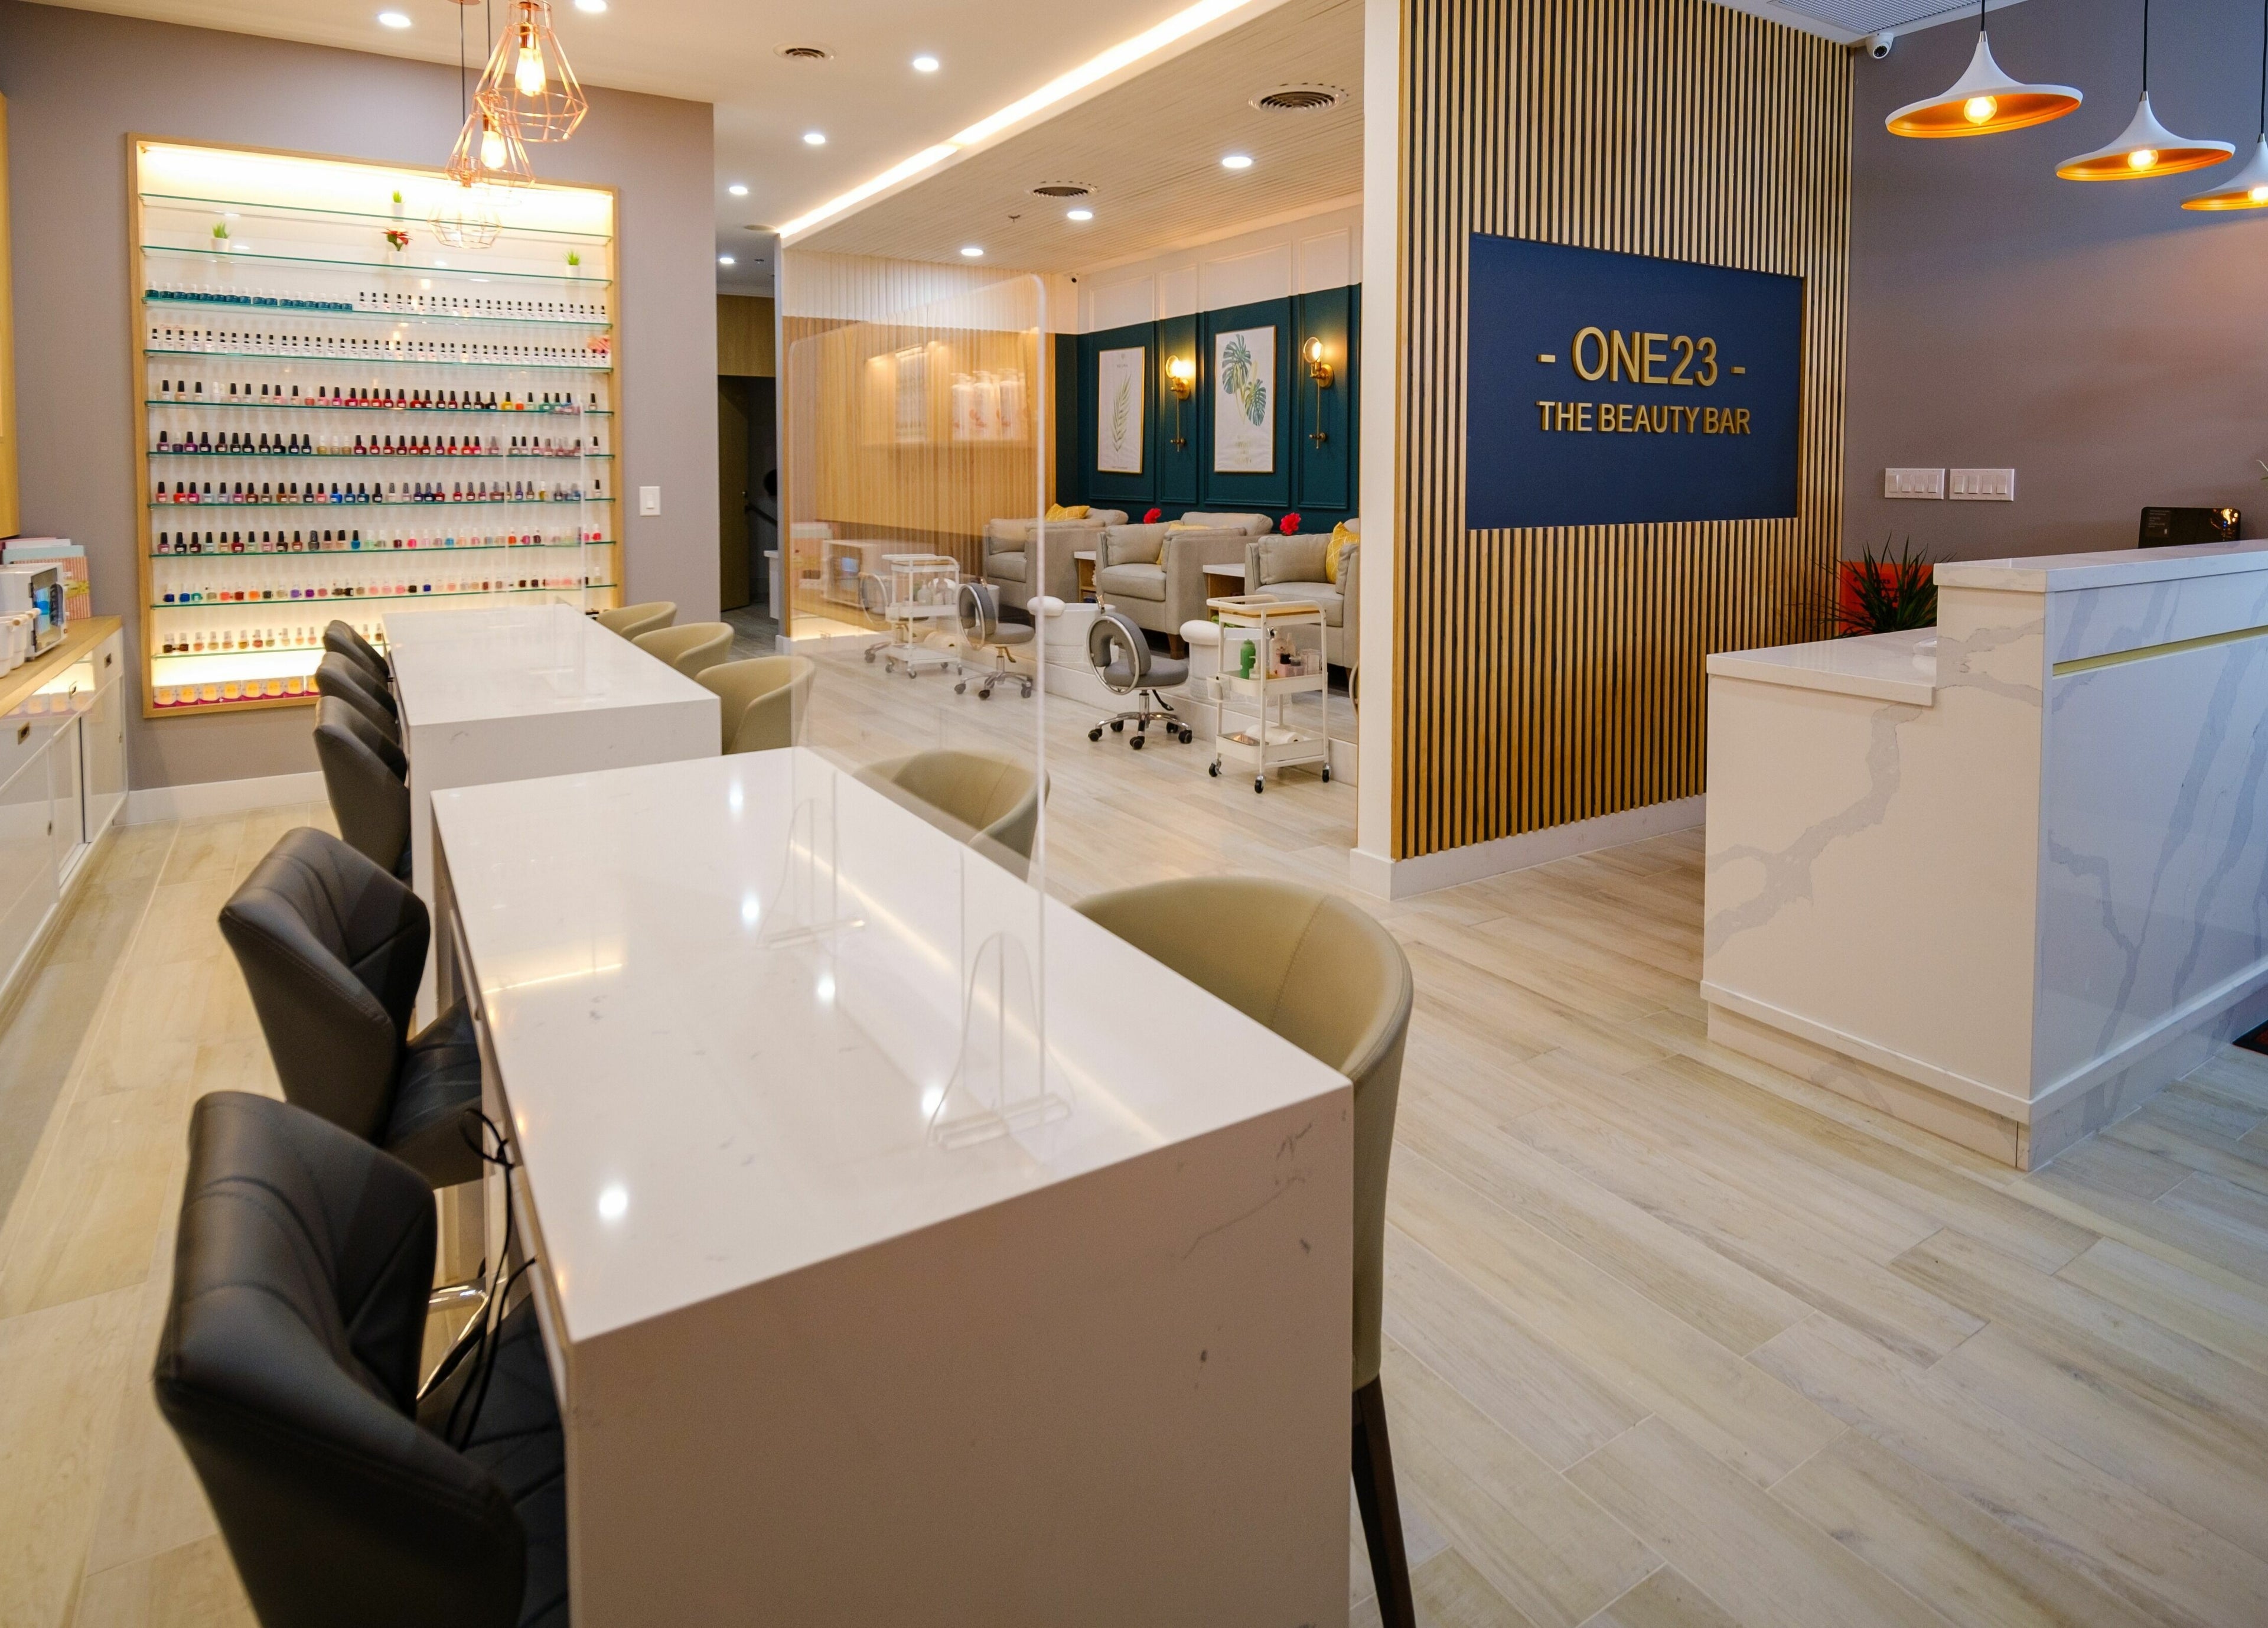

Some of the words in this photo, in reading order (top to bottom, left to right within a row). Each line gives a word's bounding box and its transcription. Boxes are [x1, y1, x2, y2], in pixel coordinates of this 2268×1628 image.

[1572, 326, 1718, 386] ONE23
[1536, 401, 1593, 431] THE
[1598, 403, 1700, 434] BEAUTY
[1703, 407, 1751, 435] BAR
